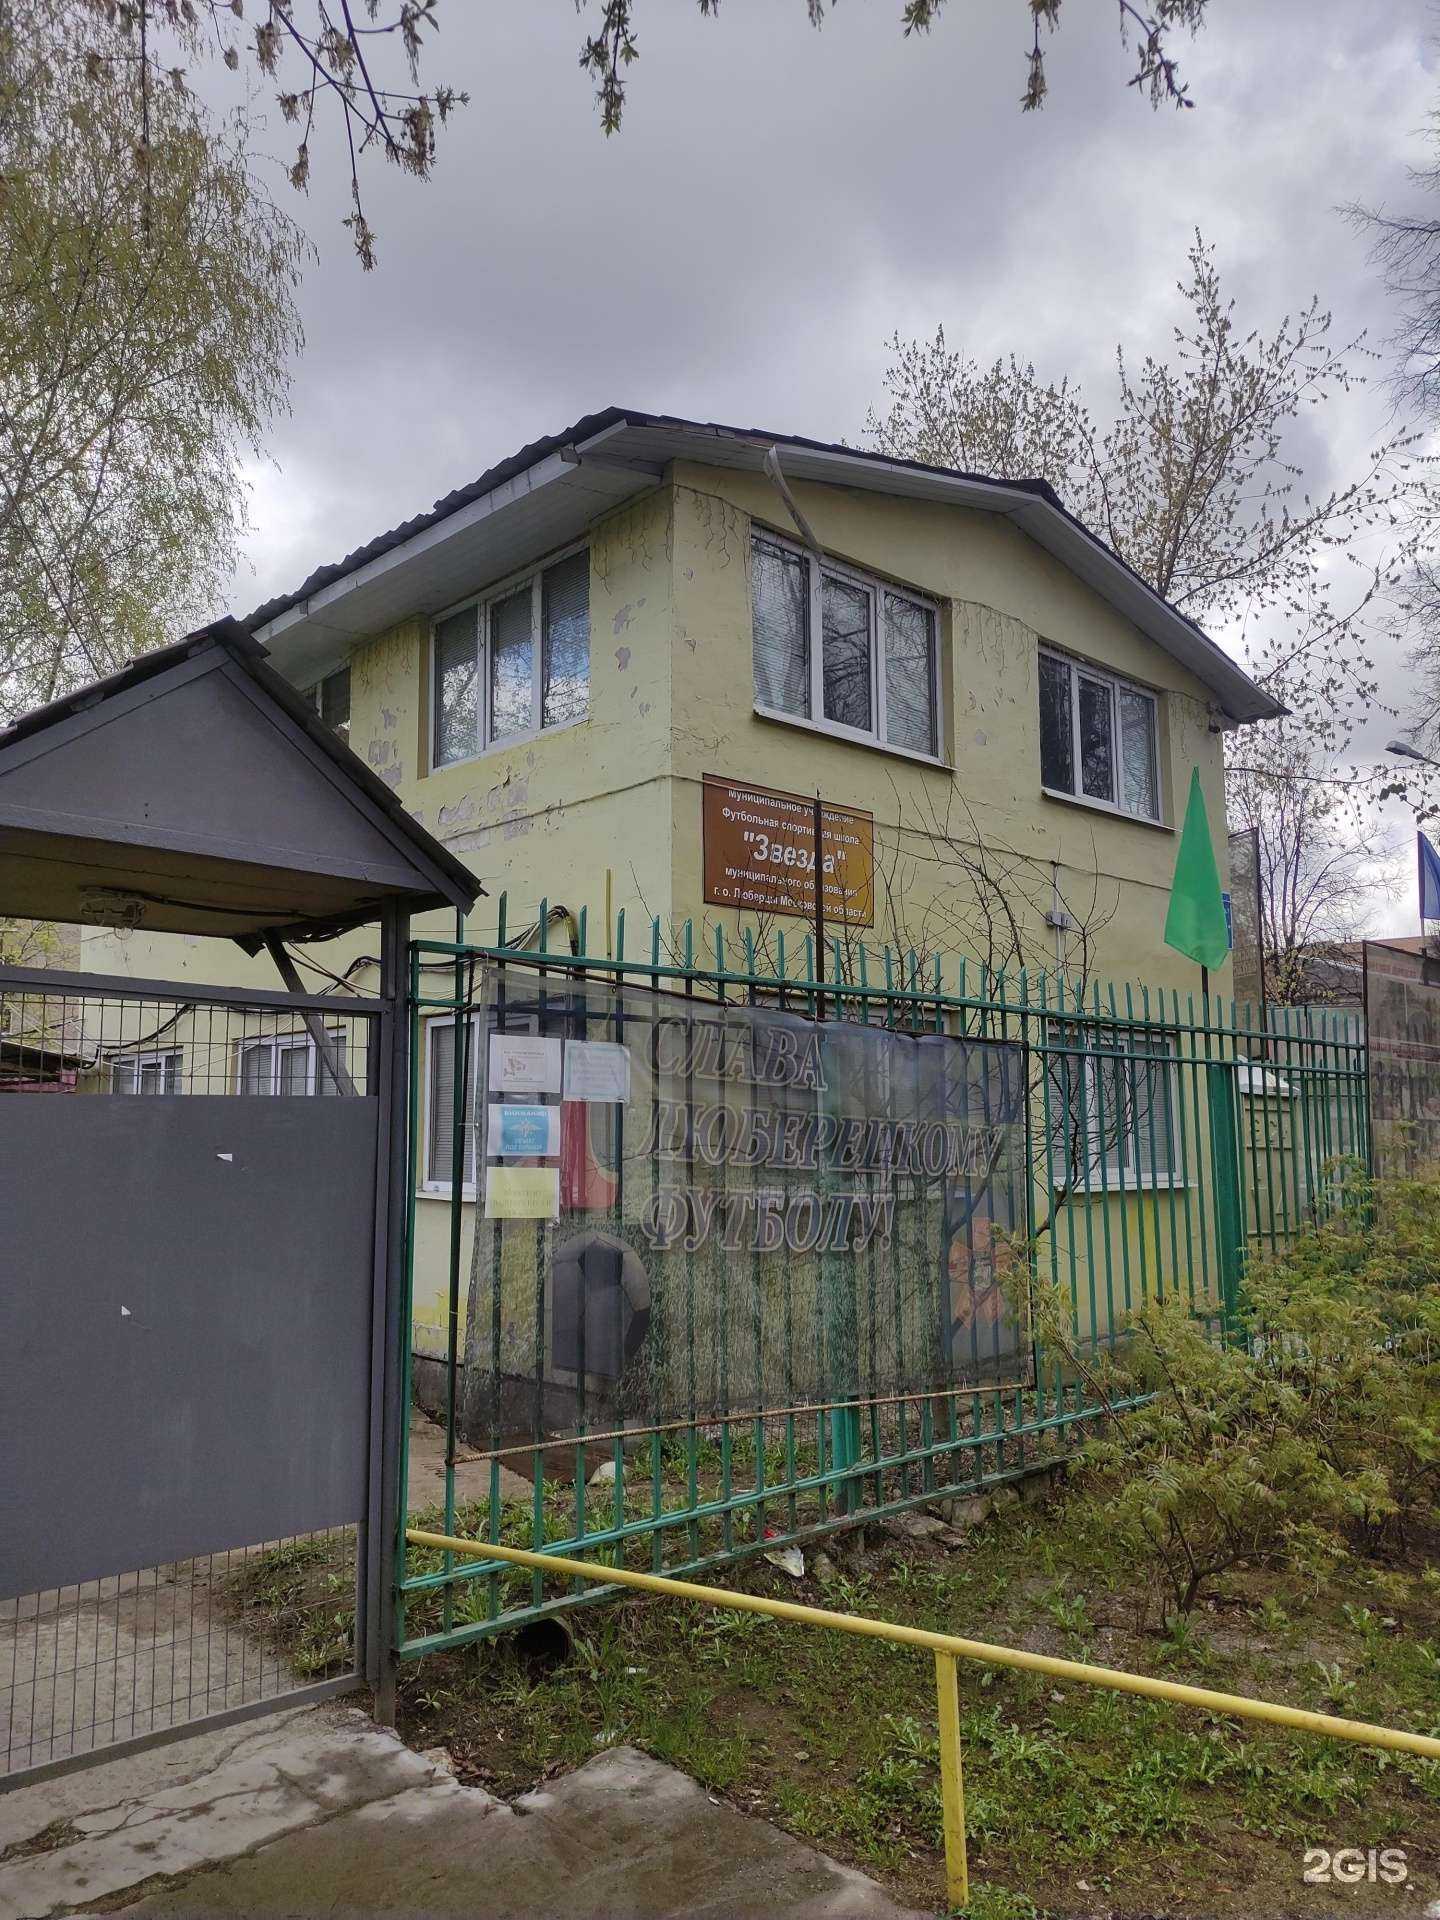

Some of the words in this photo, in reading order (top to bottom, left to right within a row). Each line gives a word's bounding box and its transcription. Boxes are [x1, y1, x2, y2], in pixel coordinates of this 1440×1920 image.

[722, 807, 779, 828] Футбольная
[728, 789, 802, 813] Муниципальное
[645, 1016, 829, 1092] СЛАВА
[636, 1097, 1003, 1189] ЛЮБЕРЕЦКОМУ
[640, 1184, 896, 1253] ФУТБОЛУ!
